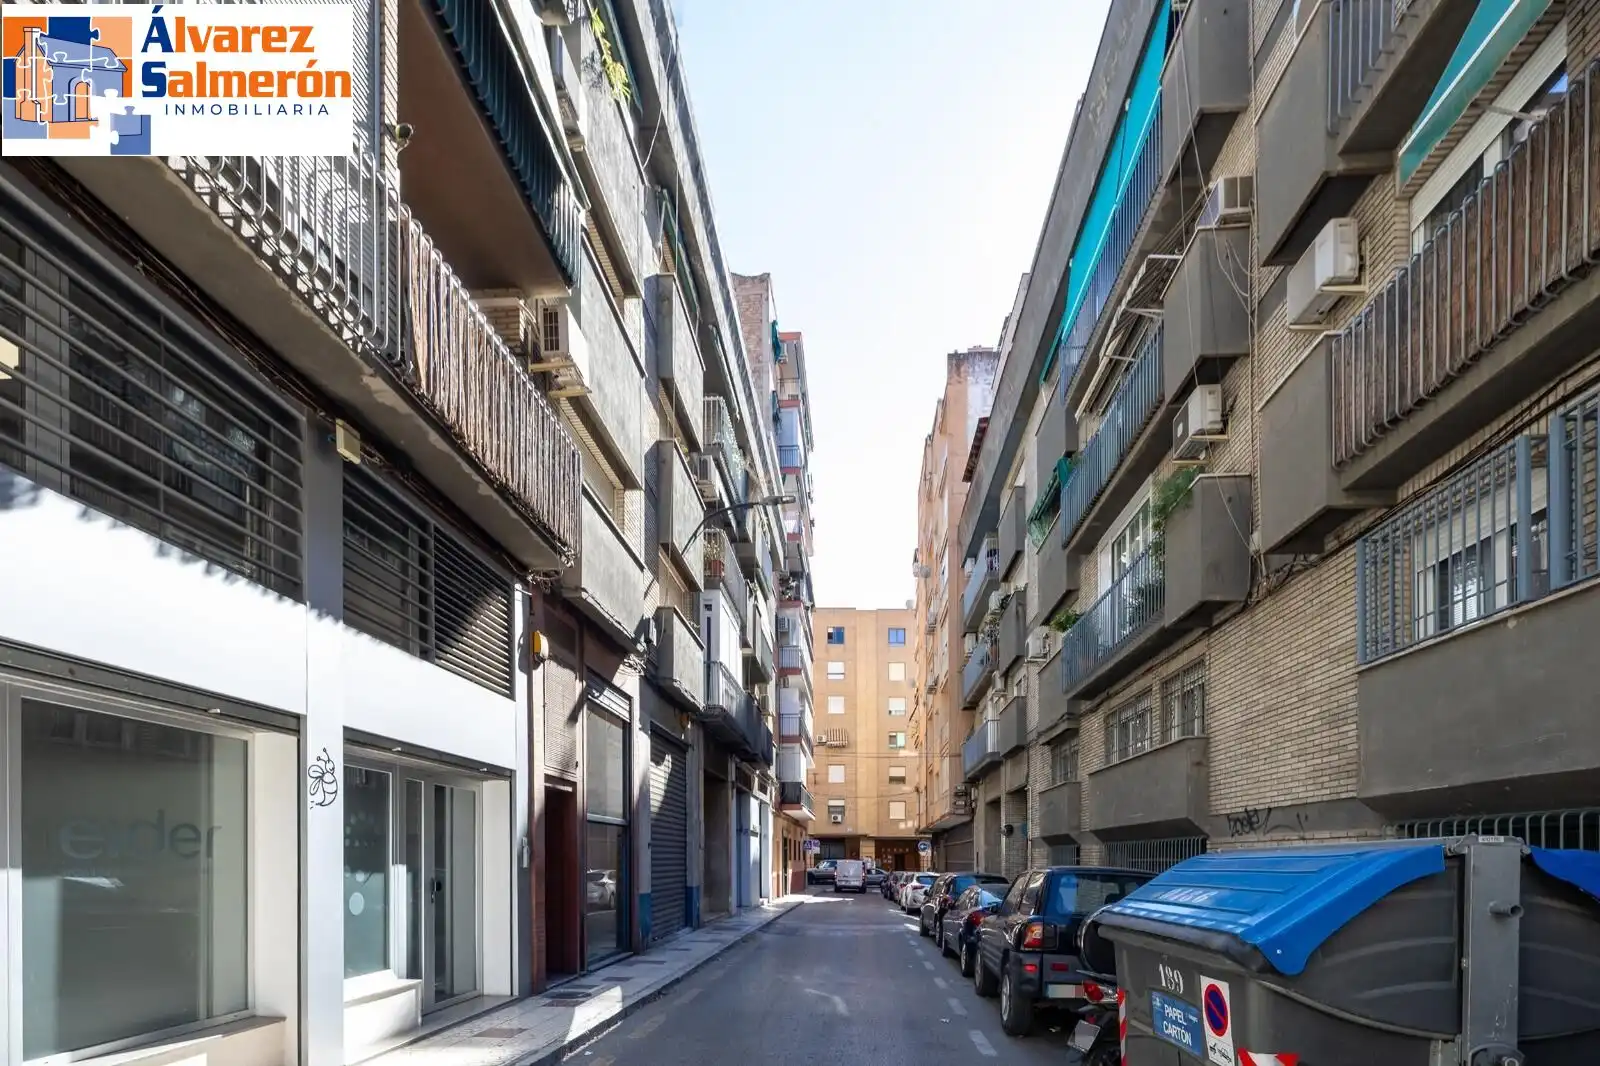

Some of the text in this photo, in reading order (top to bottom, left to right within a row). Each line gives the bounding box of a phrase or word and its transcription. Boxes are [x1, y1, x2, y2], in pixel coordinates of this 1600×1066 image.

[1159, 963, 1184, 994] 189
[1164, 1003, 1187, 1025] PAPEL
[1163, 1020, 1192, 1046] CARTÓN
